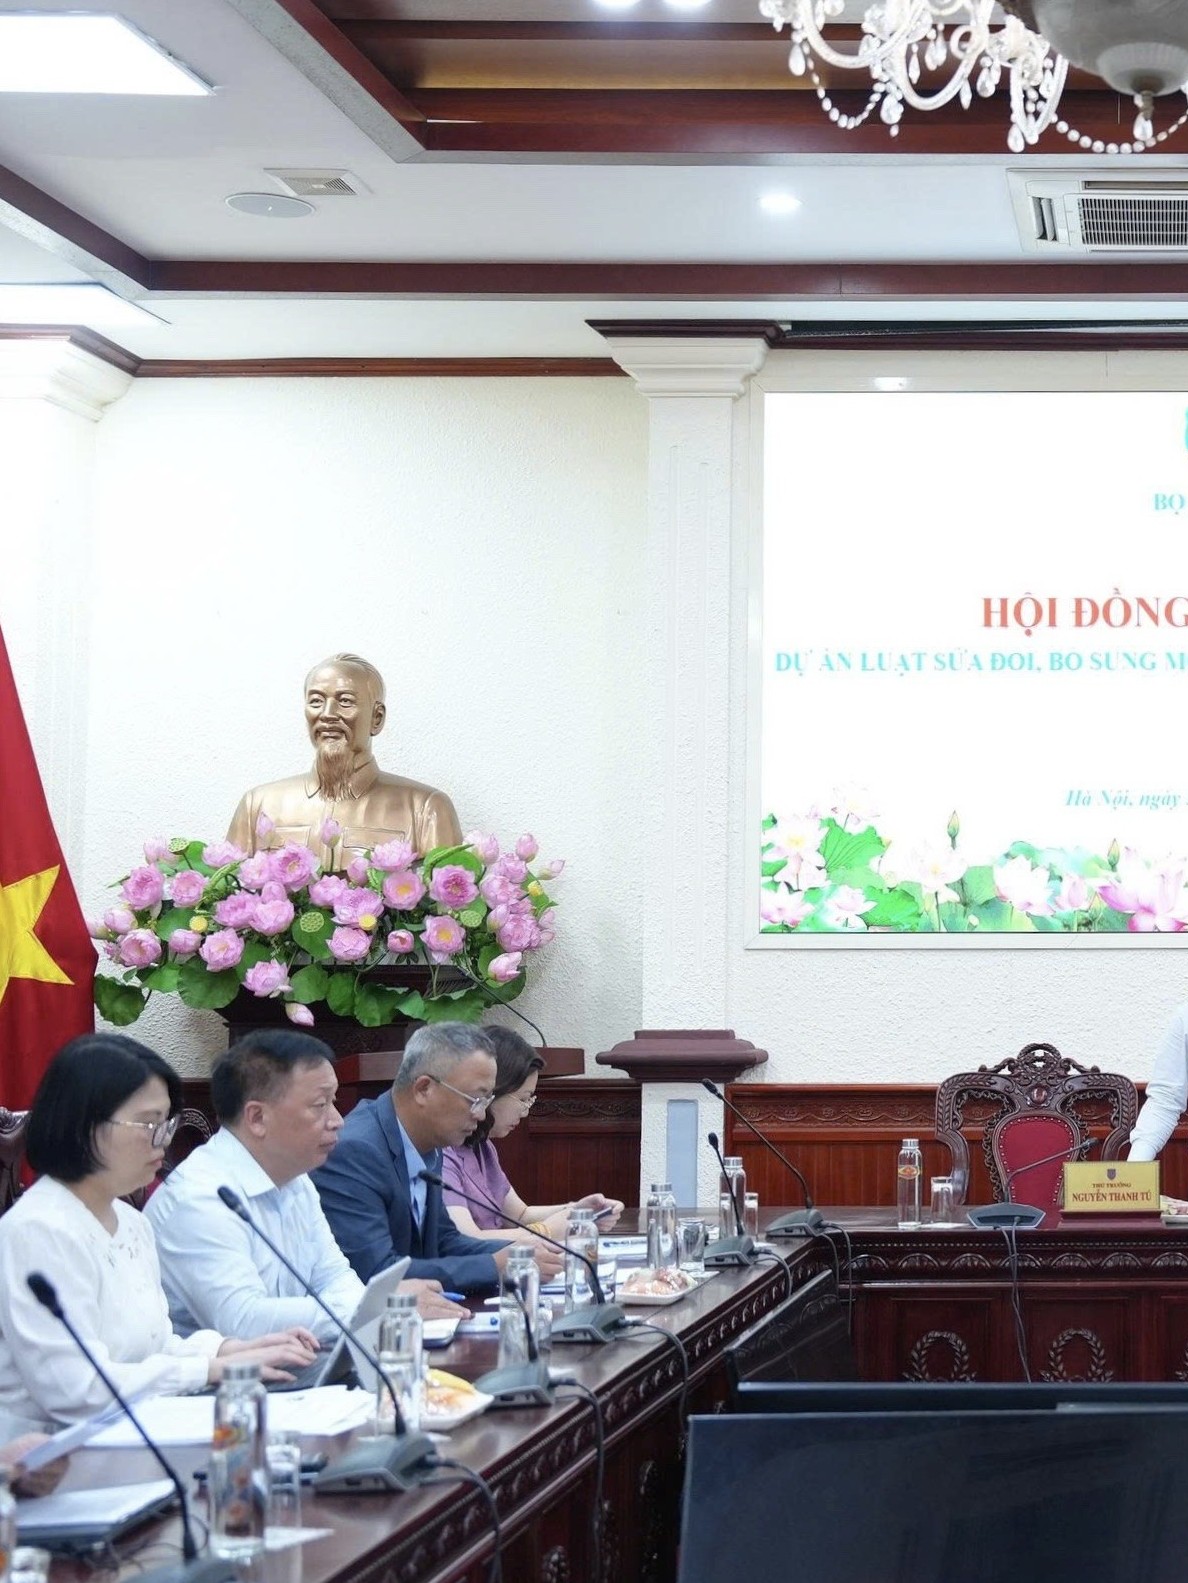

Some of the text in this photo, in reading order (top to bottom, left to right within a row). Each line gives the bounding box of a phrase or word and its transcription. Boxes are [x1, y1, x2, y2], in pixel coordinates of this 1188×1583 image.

[983, 591, 1058, 638] HỘI
[1089, 652, 1157, 671] SUNG
[1109, 1191, 1138, 1202] THANH
